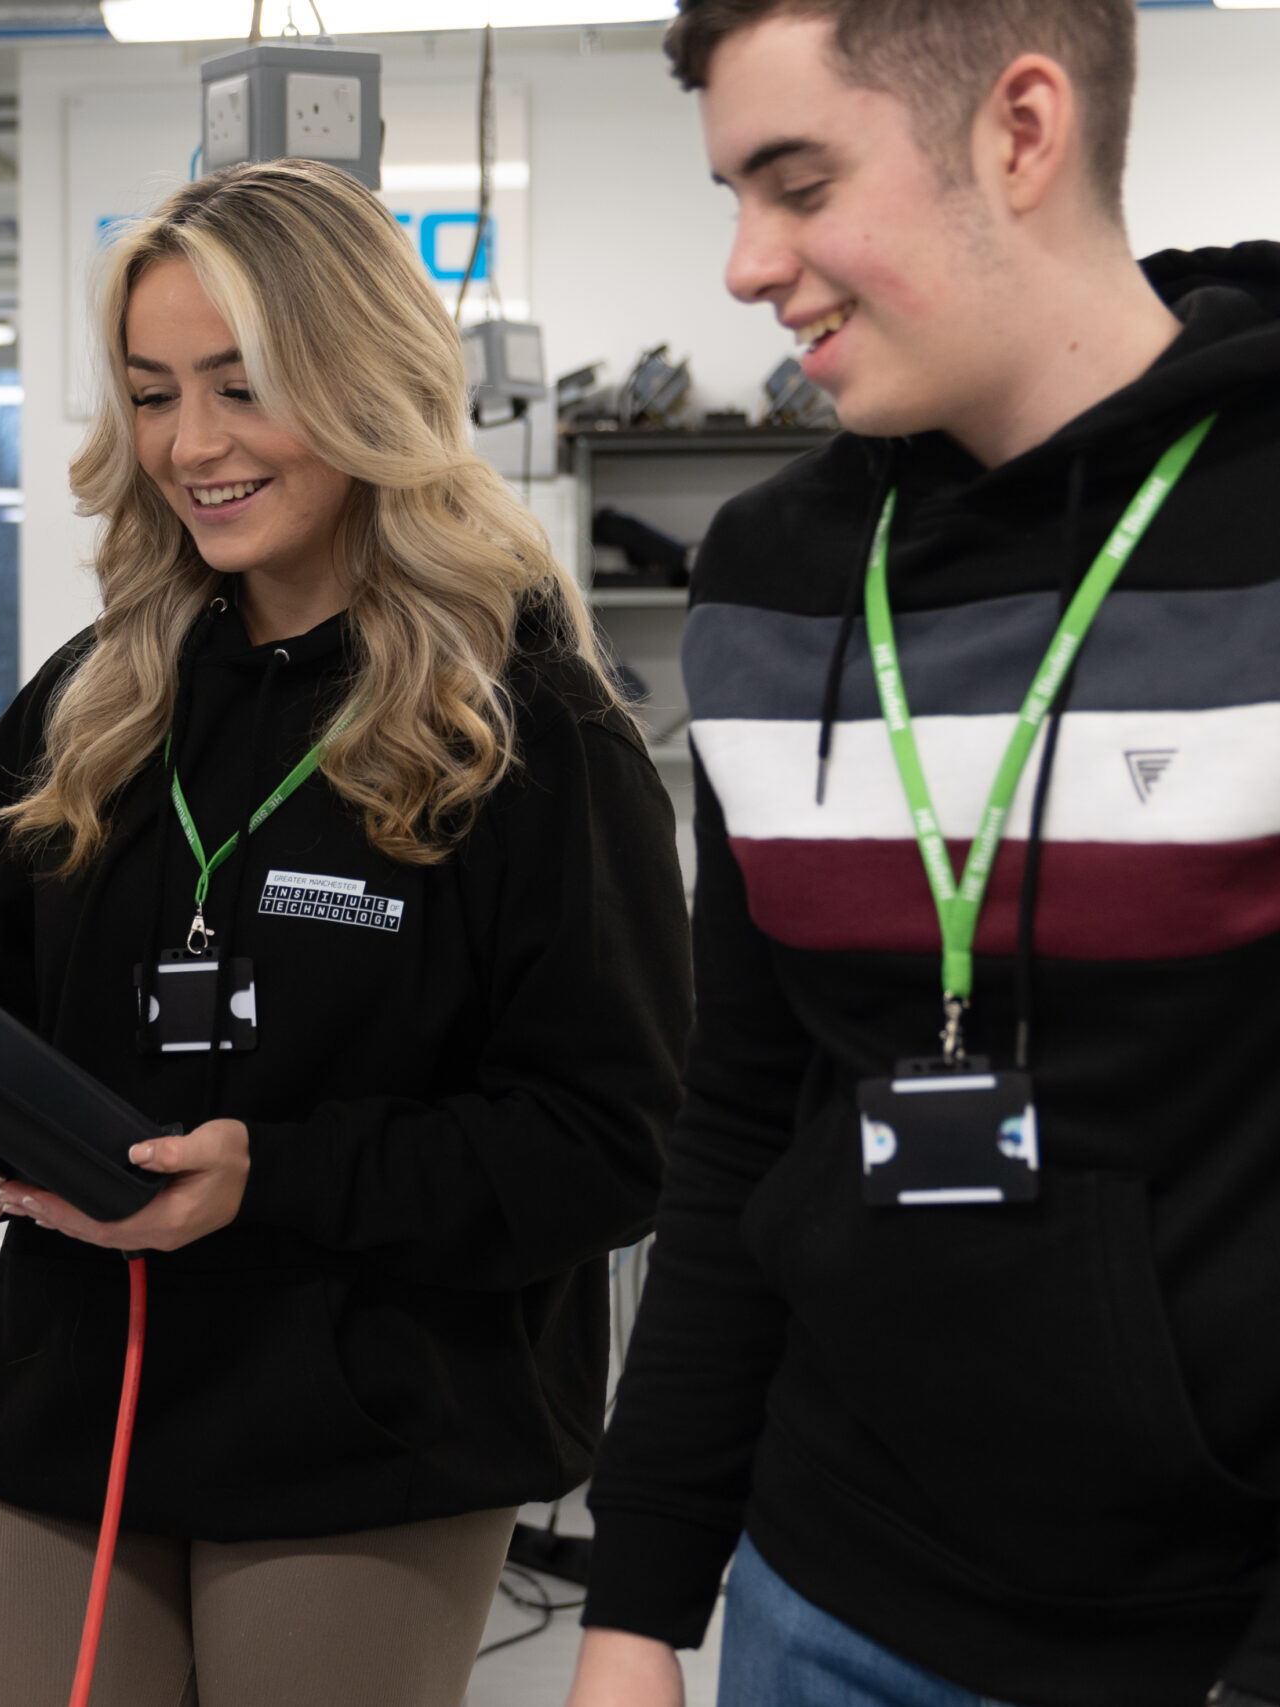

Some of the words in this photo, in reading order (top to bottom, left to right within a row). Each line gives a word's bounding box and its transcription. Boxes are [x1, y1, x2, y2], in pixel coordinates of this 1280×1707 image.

[267, 793, 284, 812] HE
[184, 826, 195, 844] HE
[273, 874, 308, 885] GREATER
[309, 878, 358, 891] MANCHESTER
[266, 885, 386, 911] INSTITUTE
[389, 903, 401, 912] OF
[263, 900, 397, 928] TECHNOLOGY
